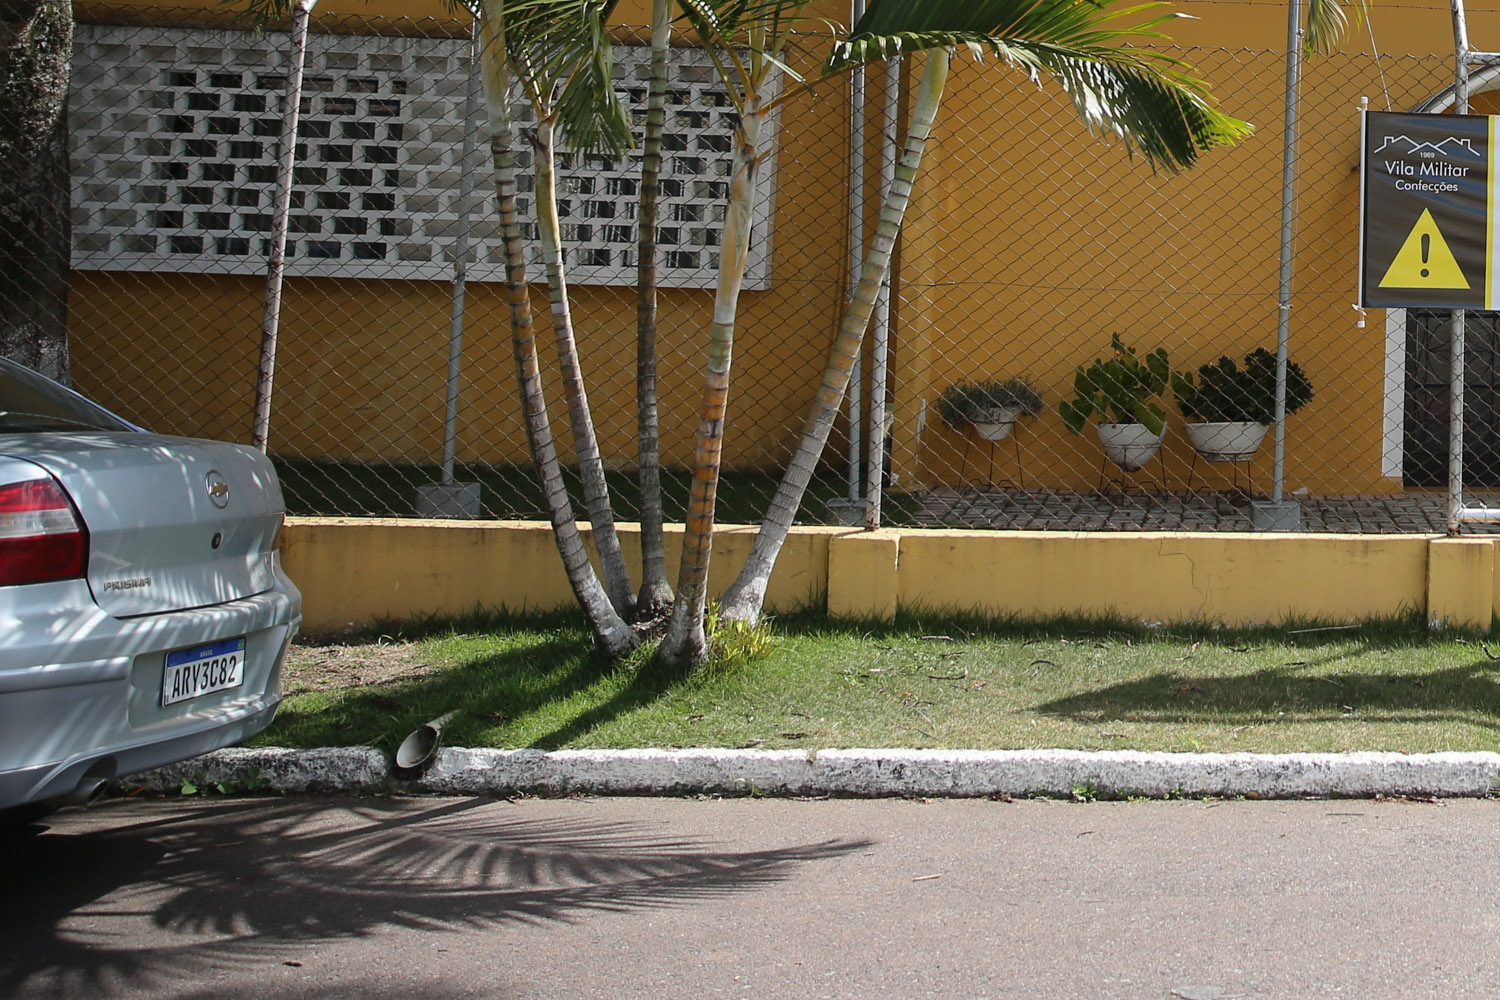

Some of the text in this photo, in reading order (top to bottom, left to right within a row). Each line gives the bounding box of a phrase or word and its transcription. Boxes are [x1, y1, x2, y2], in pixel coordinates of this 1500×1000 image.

[1384, 160, 1470, 177] Vila Militar
[1395, 179, 1459, 194] Confecções
[171, 655, 237, 699] ARY3C82
